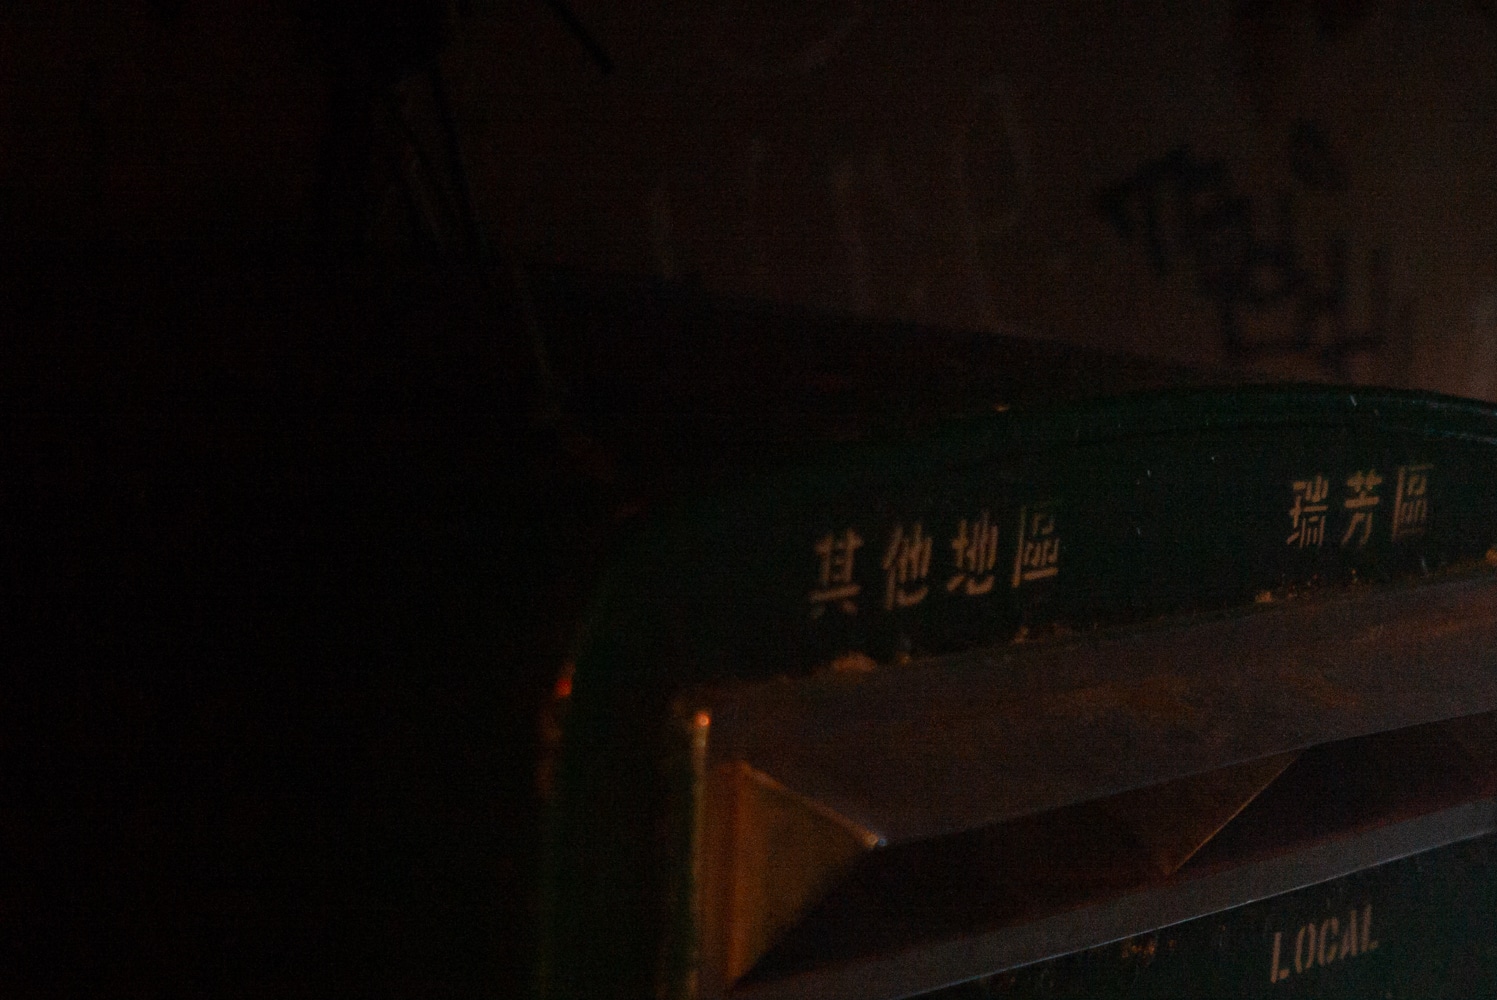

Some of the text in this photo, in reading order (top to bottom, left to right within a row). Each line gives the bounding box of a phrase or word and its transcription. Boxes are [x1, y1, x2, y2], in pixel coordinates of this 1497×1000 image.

[1285, 463, 1434, 550] 瑞芳區
[807, 506, 1061, 620] 其他地區
[1269, 903, 1379, 985] LOCAL
